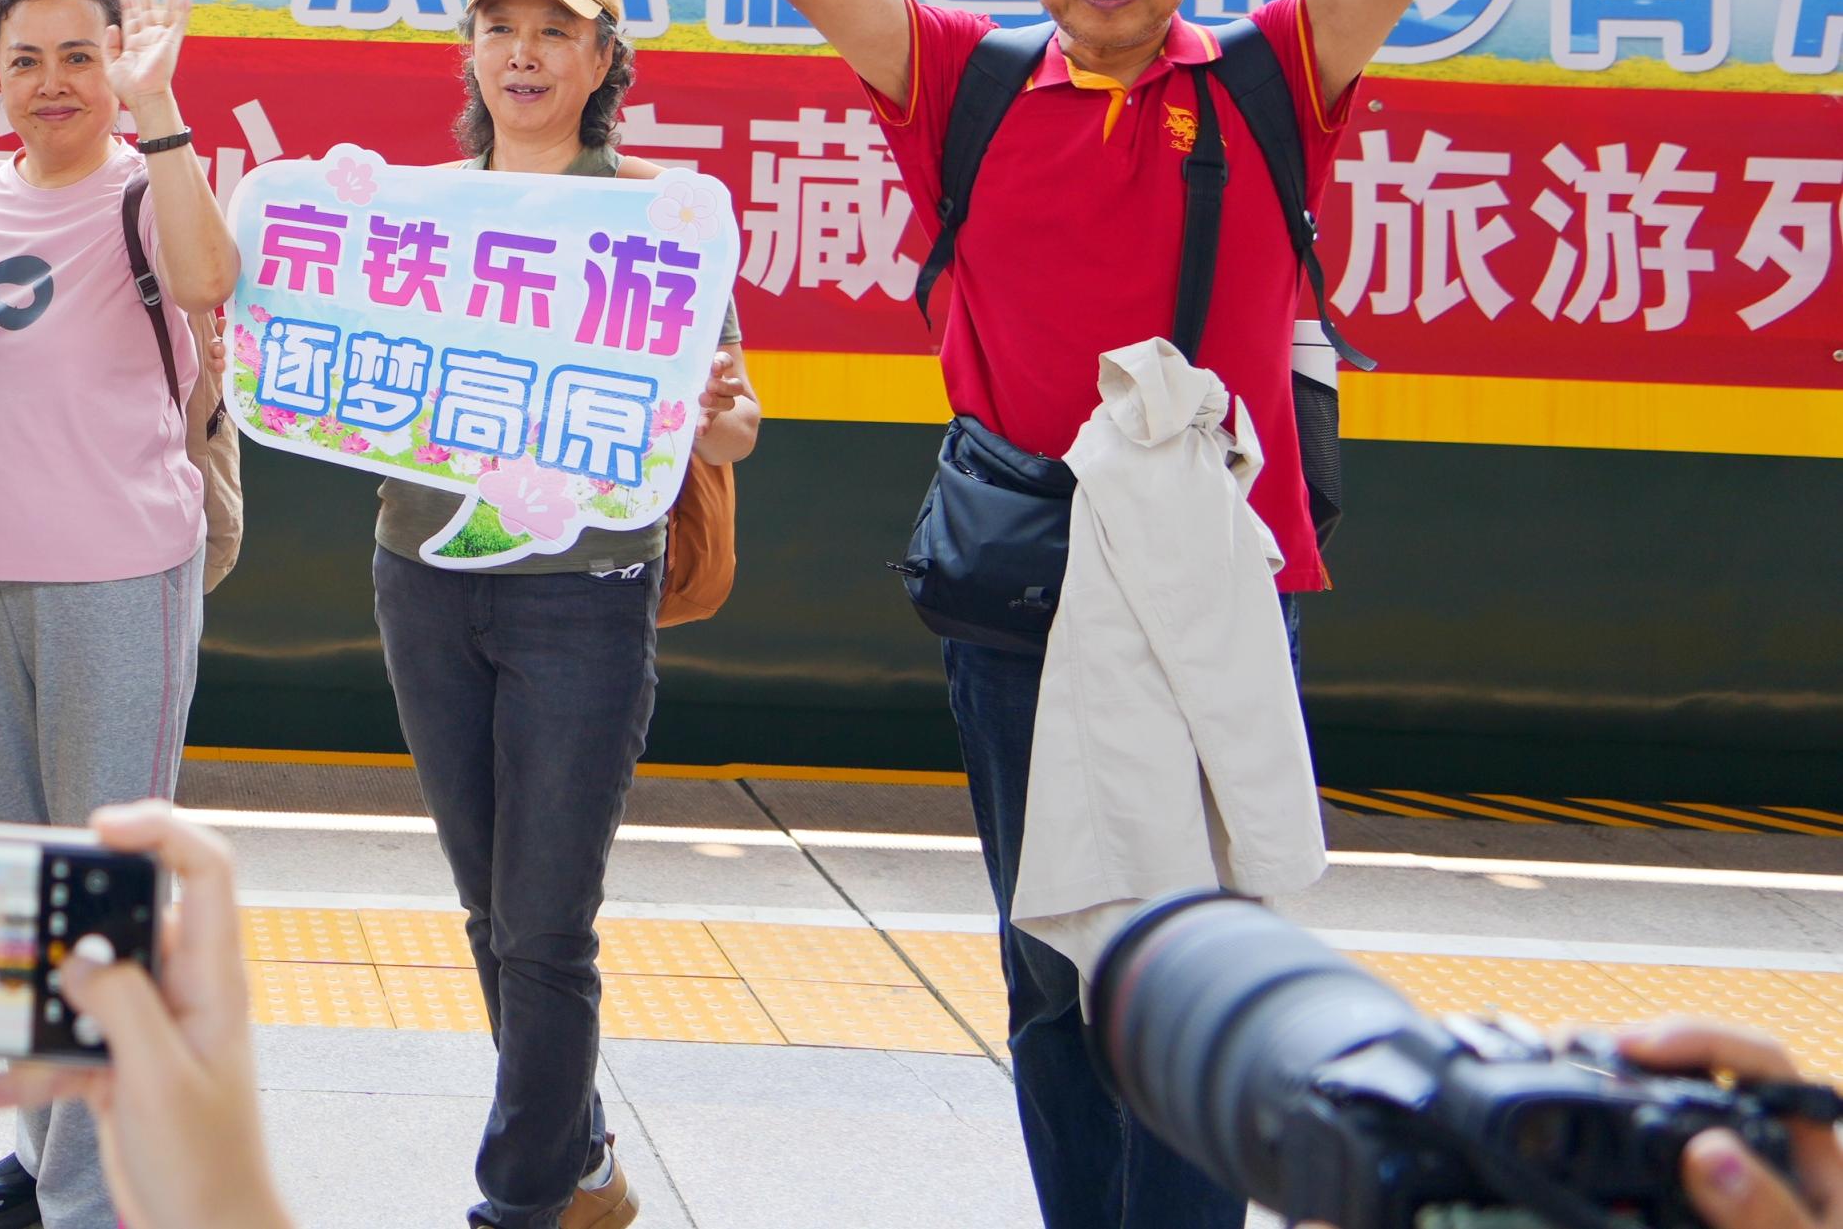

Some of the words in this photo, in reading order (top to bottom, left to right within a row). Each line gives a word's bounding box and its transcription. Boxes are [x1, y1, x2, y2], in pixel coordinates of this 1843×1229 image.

[257, 203, 702, 357] 京铁乐游
[257, 316, 659, 489] 逐梦高原
